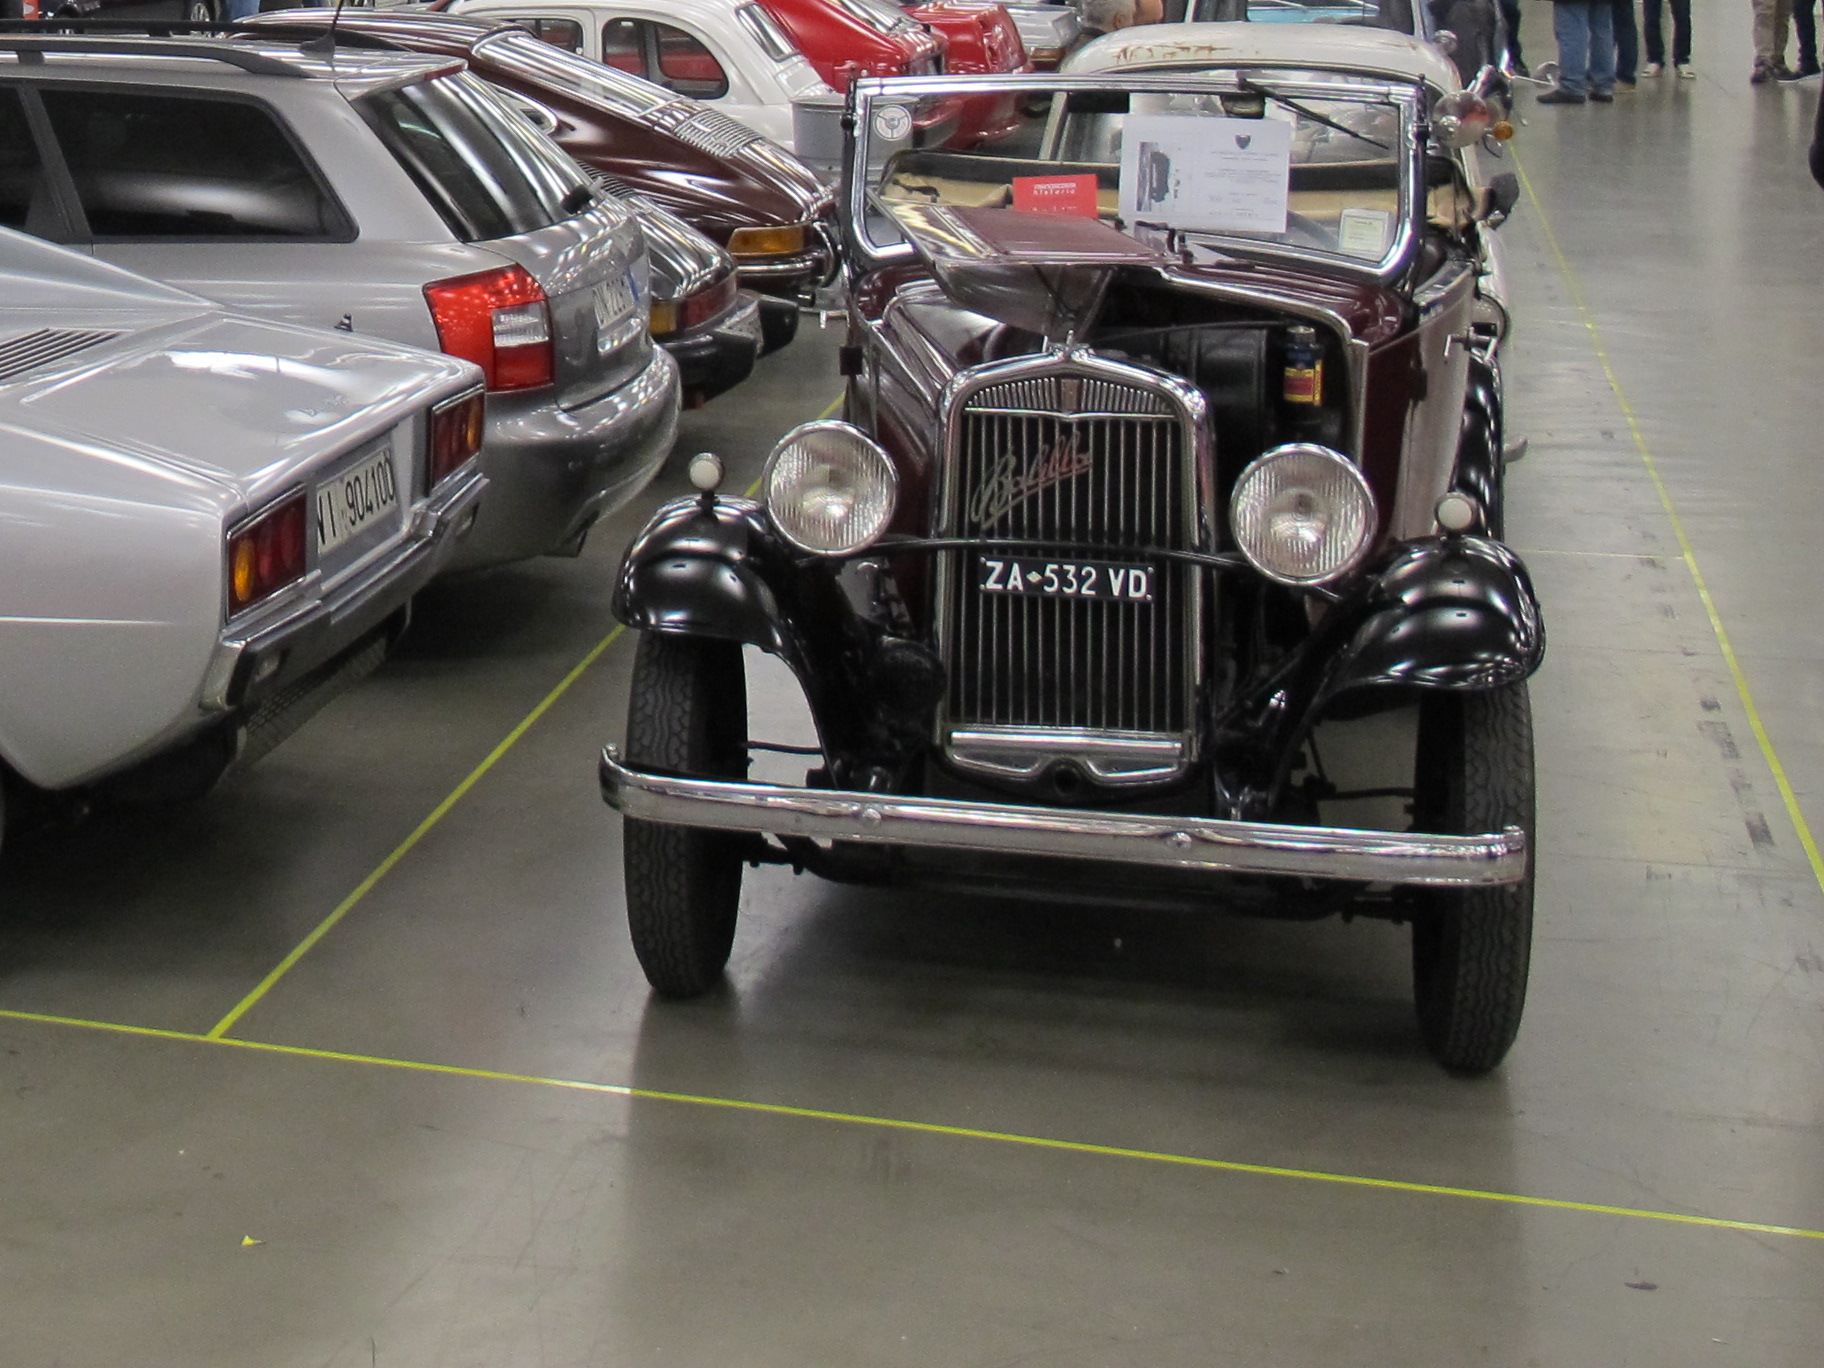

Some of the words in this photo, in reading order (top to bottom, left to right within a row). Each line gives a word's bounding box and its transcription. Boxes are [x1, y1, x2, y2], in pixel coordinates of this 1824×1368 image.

[345, 457, 395, 526] 904100
[985, 560, 1024, 592] ZA
[1043, 563, 1097, 596] 532
[1108, 567, 1148, 599] VD
